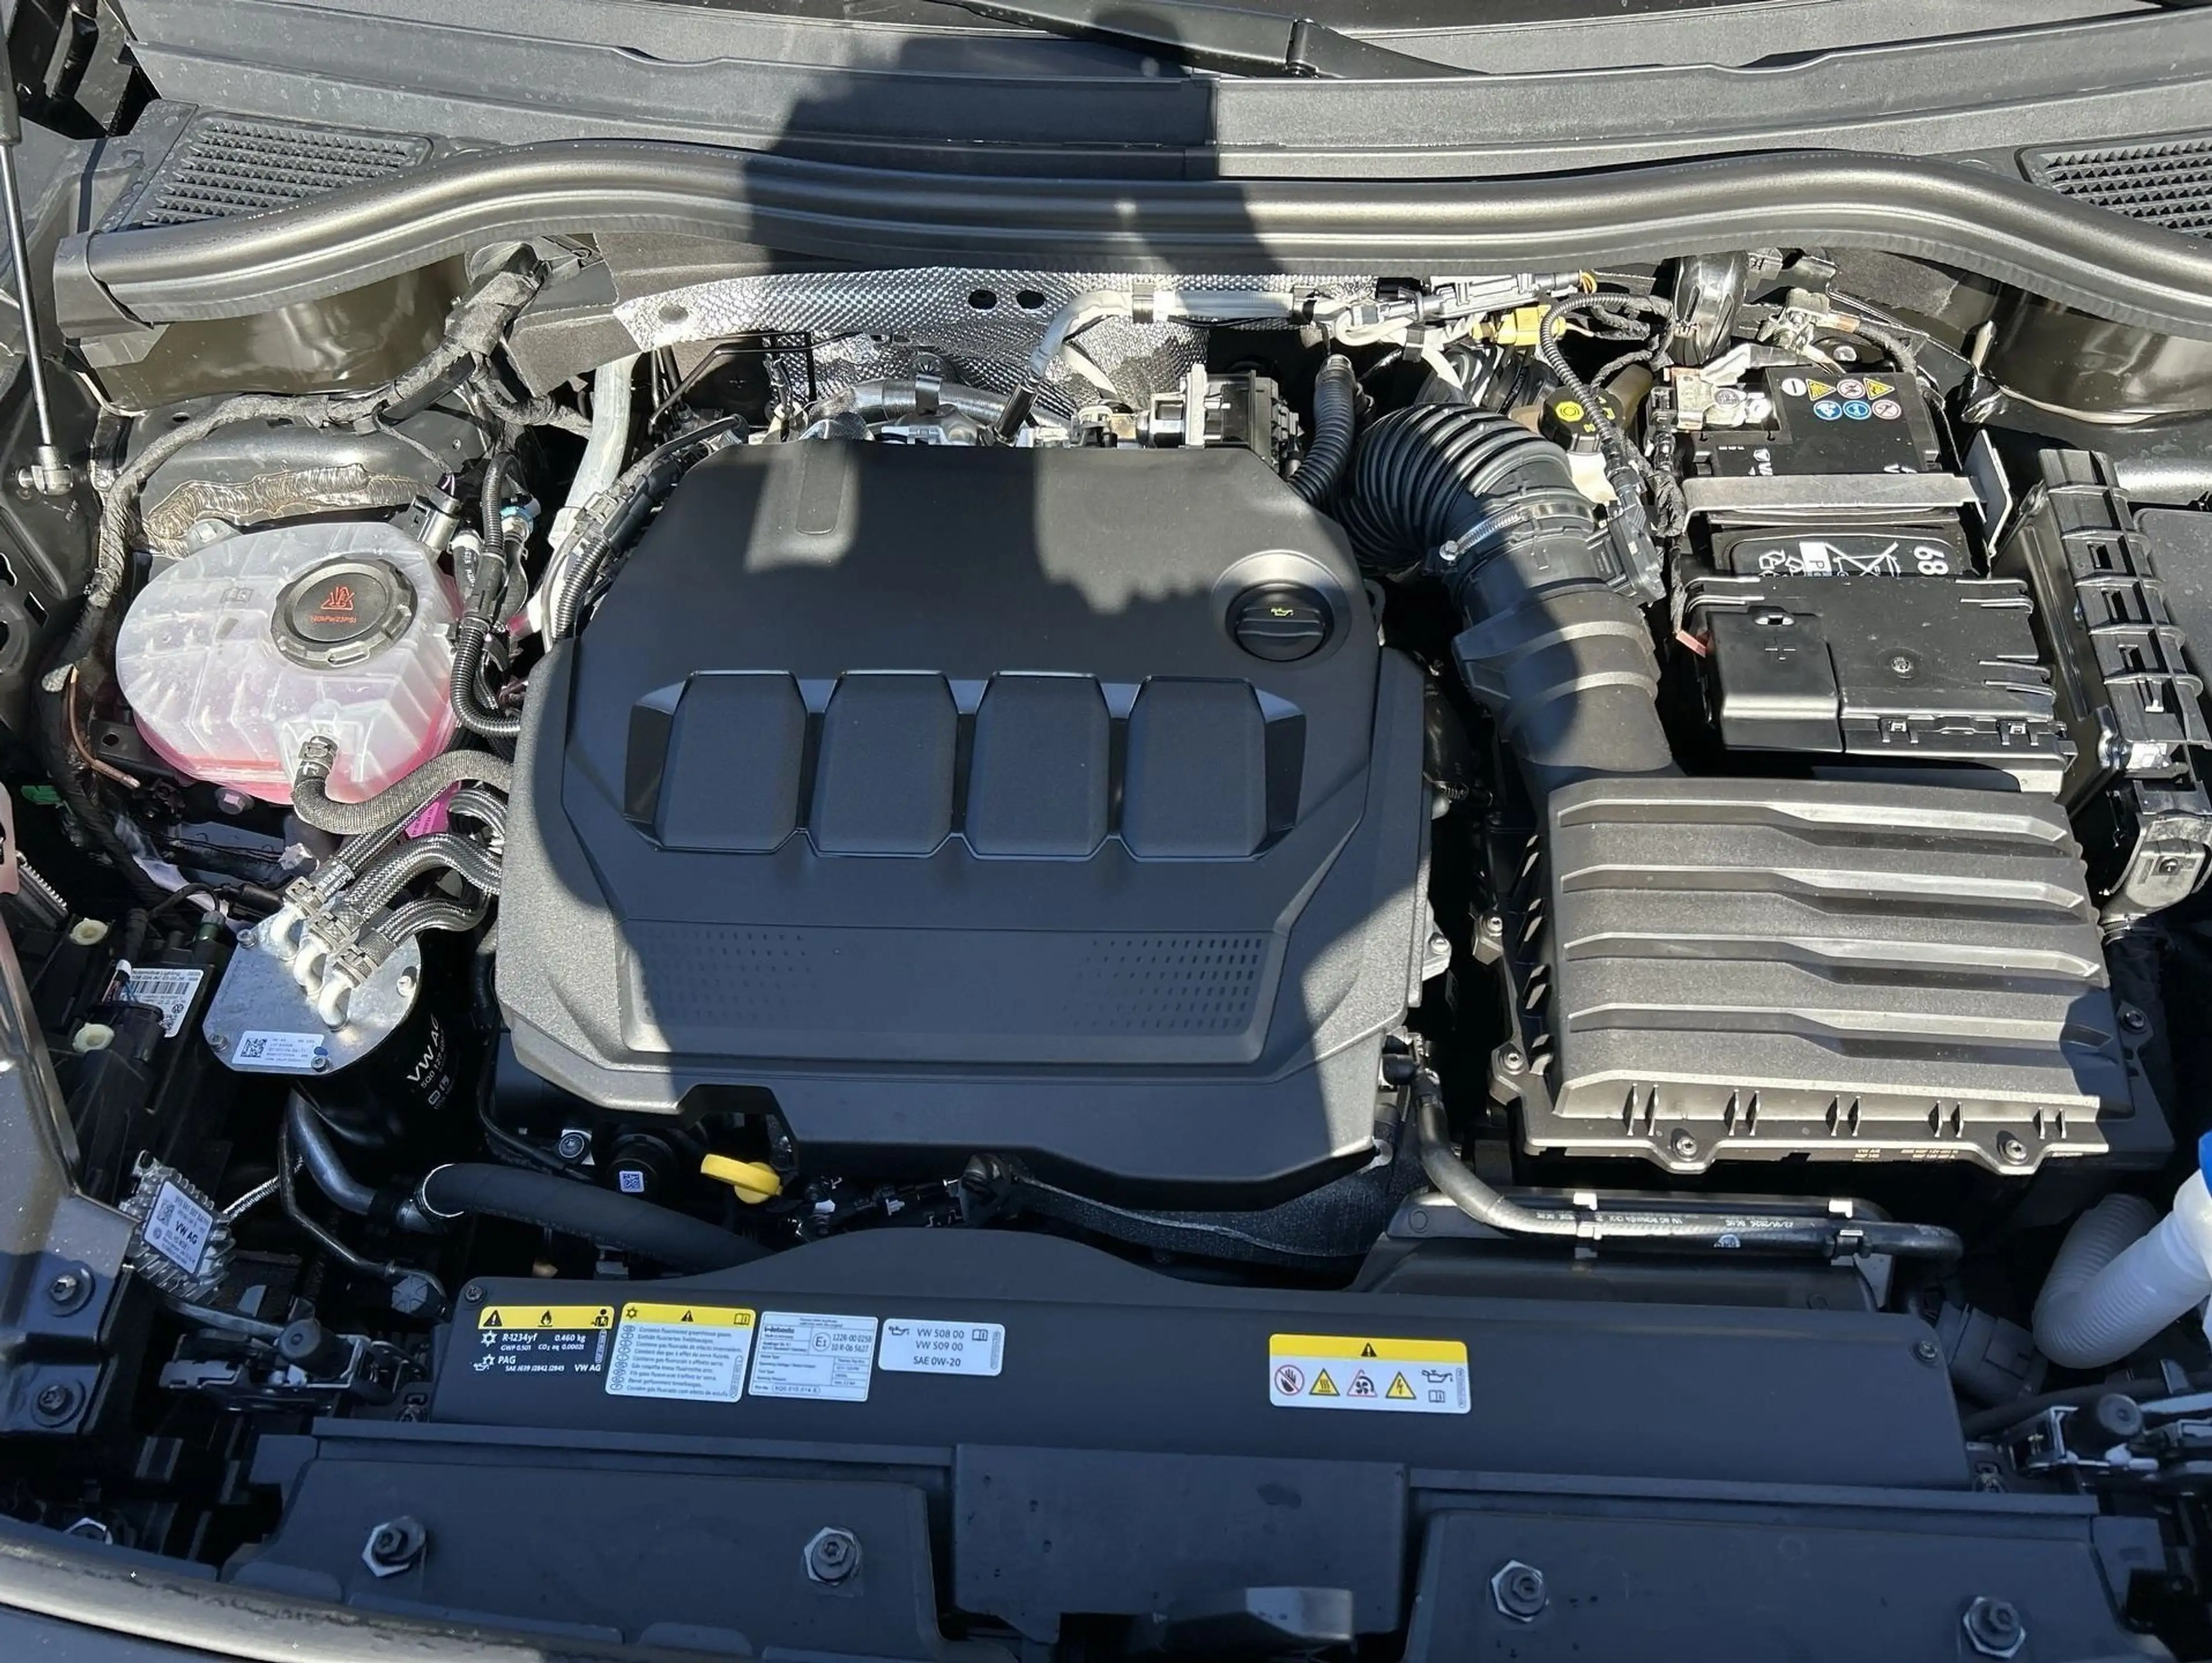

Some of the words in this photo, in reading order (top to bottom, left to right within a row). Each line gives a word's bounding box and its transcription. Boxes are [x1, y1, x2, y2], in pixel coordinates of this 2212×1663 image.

[407, 1045, 434, 1081] VW
[176, 1221, 189, 1236] VW
[187, 1231, 198, 1245] AG
[502, 1333, 538, 1344] R-1234yf
[577, 1334, 587, 1343] kg
[917, 1328, 932, 1337] VW
[934, 1329, 951, 1338] 508
[953, 1330, 965, 1339] 00
[915, 1340, 930, 1349] VW
[933, 1341, 949, 1350] 509
[951, 1342, 963, 1351] 00
[498, 1355, 516, 1364] PAG
[914, 1356, 929, 1365] SAE
[931, 1357, 961, 1367] 0W-20
[575, 1364, 589, 1372] VW
